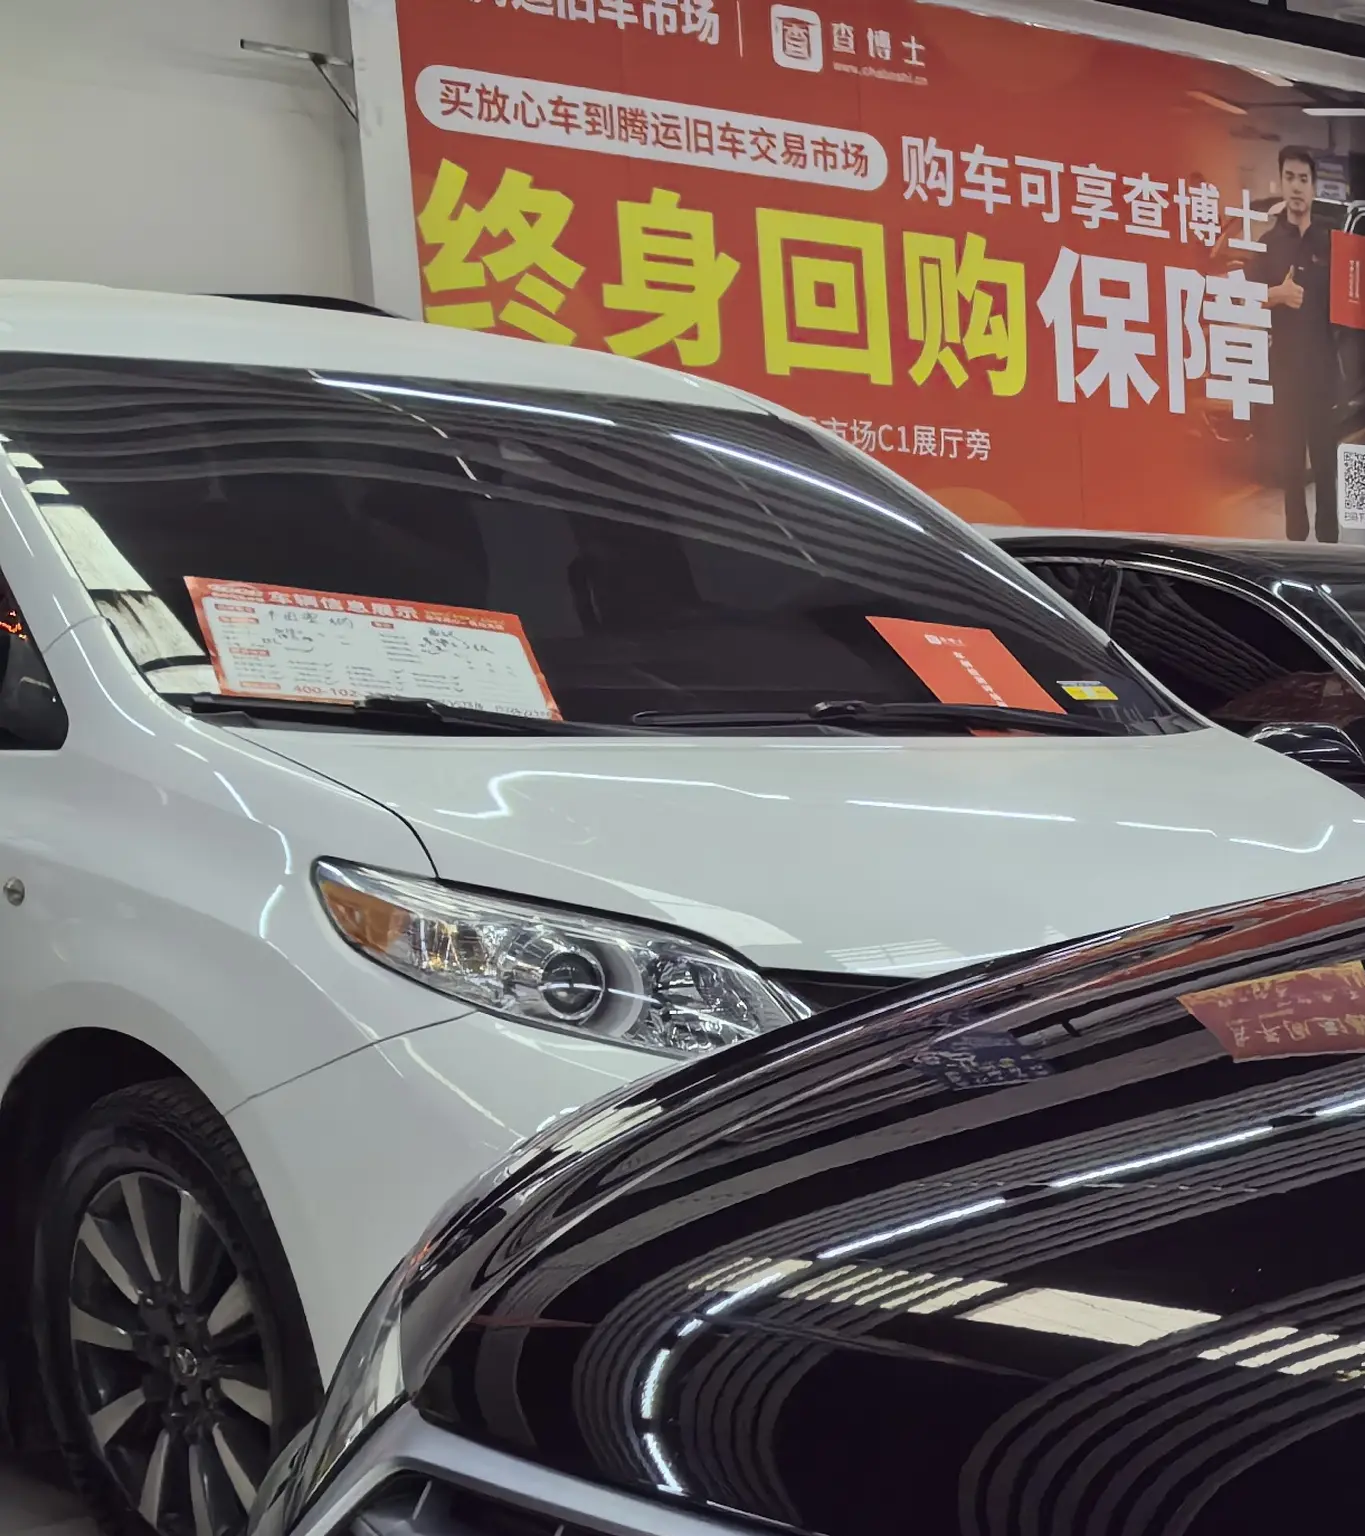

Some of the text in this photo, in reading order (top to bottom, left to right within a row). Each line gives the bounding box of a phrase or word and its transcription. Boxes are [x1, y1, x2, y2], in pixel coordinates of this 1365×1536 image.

[468, 0, 720, 45] 旧车市场
[832, 21, 926, 67] 查博士
[439, 78, 869, 178] 买放心车到腾运旧车交易市场
[901, 135, 1269, 254] 购车可享查博士
[419, 157, 1275, 423] 终身回购保障
[803, 413, 991, 462] 市场C1展厅旁
